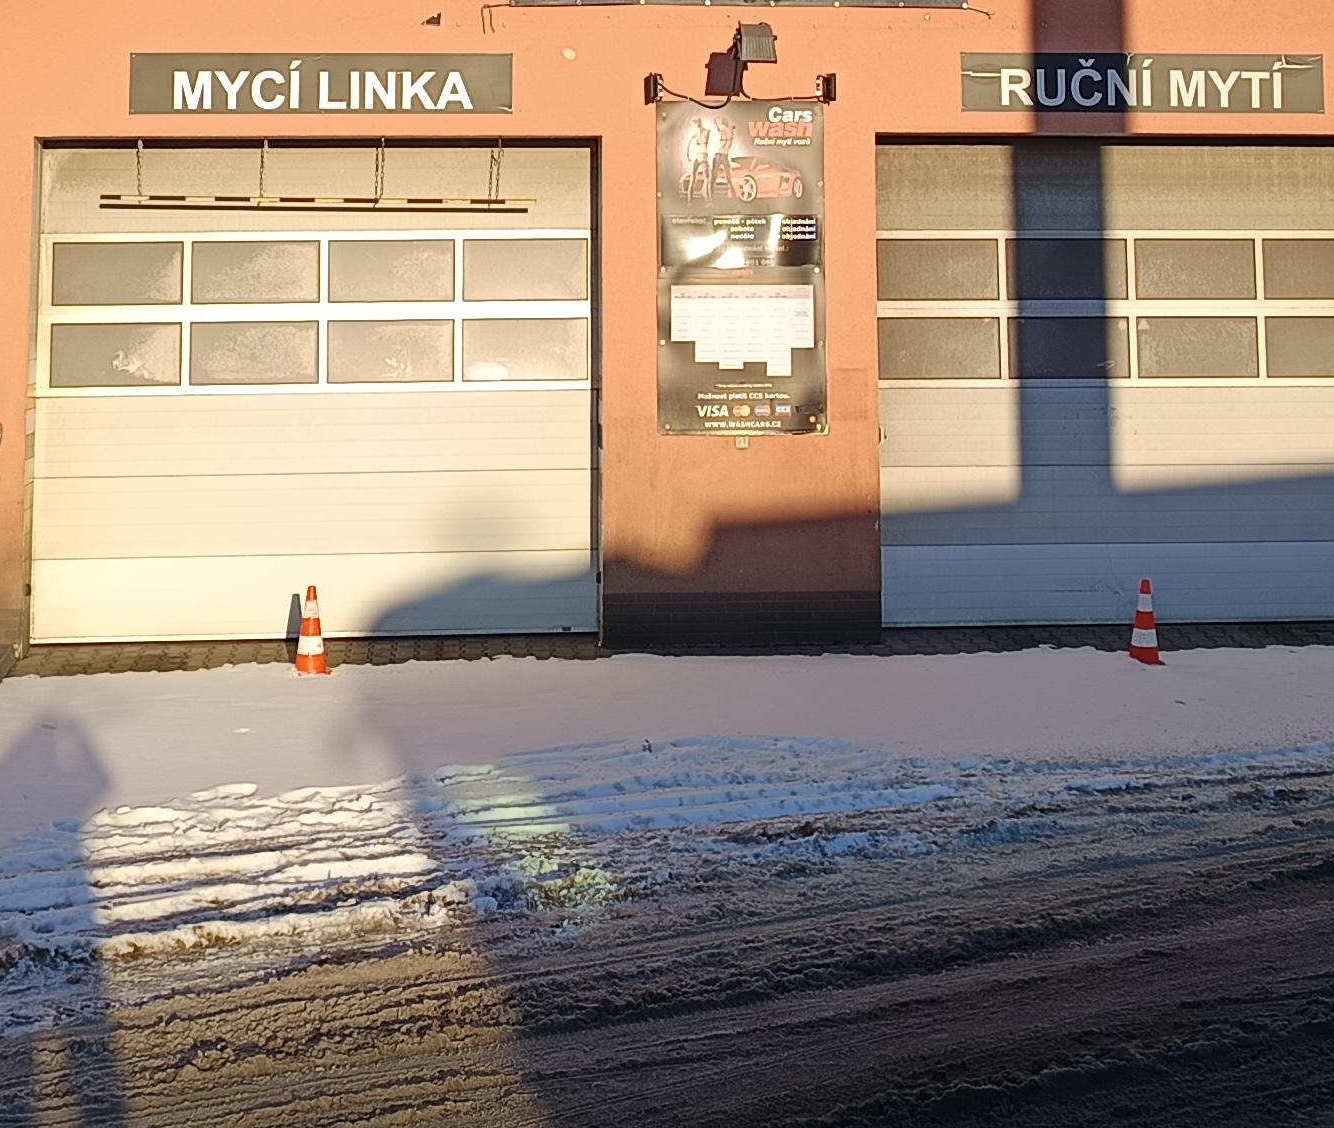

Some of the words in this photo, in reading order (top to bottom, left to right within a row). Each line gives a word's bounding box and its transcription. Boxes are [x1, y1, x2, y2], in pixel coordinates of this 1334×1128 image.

[173, 60, 302, 110] MYCÍ
[318, 71, 474, 110] LINKA
[1000, 58, 1153, 107] RUČNÍ
[1170, 61, 1283, 109] MYTÍ
[768, 106, 813, 123] Cars
[748, 120, 813, 137] wash
[695, 405, 729, 417] VISA
